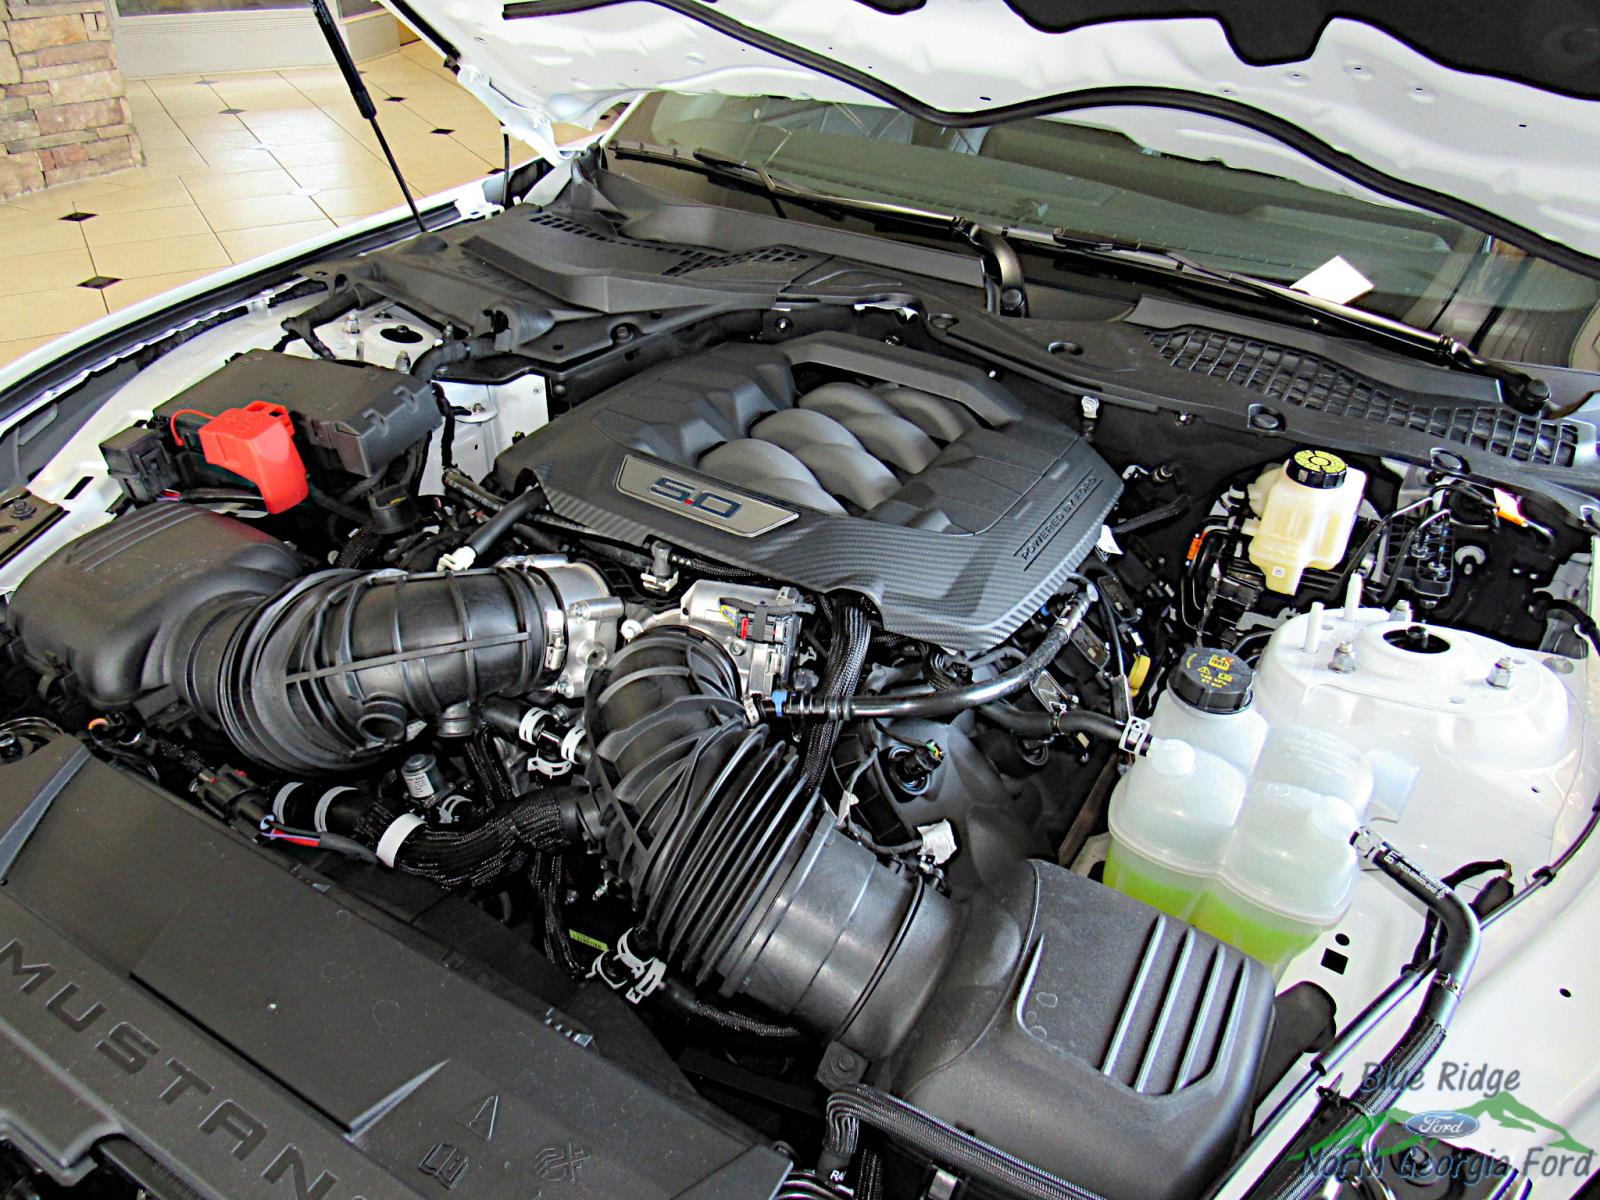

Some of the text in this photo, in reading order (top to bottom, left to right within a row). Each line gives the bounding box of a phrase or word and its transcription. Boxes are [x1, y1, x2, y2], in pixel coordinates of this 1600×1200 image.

[650, 475, 742, 519] 5.0
[1020, 475, 1097, 561] POWERED BY FORD
[0, 937, 366, 1200] MUSTAN
